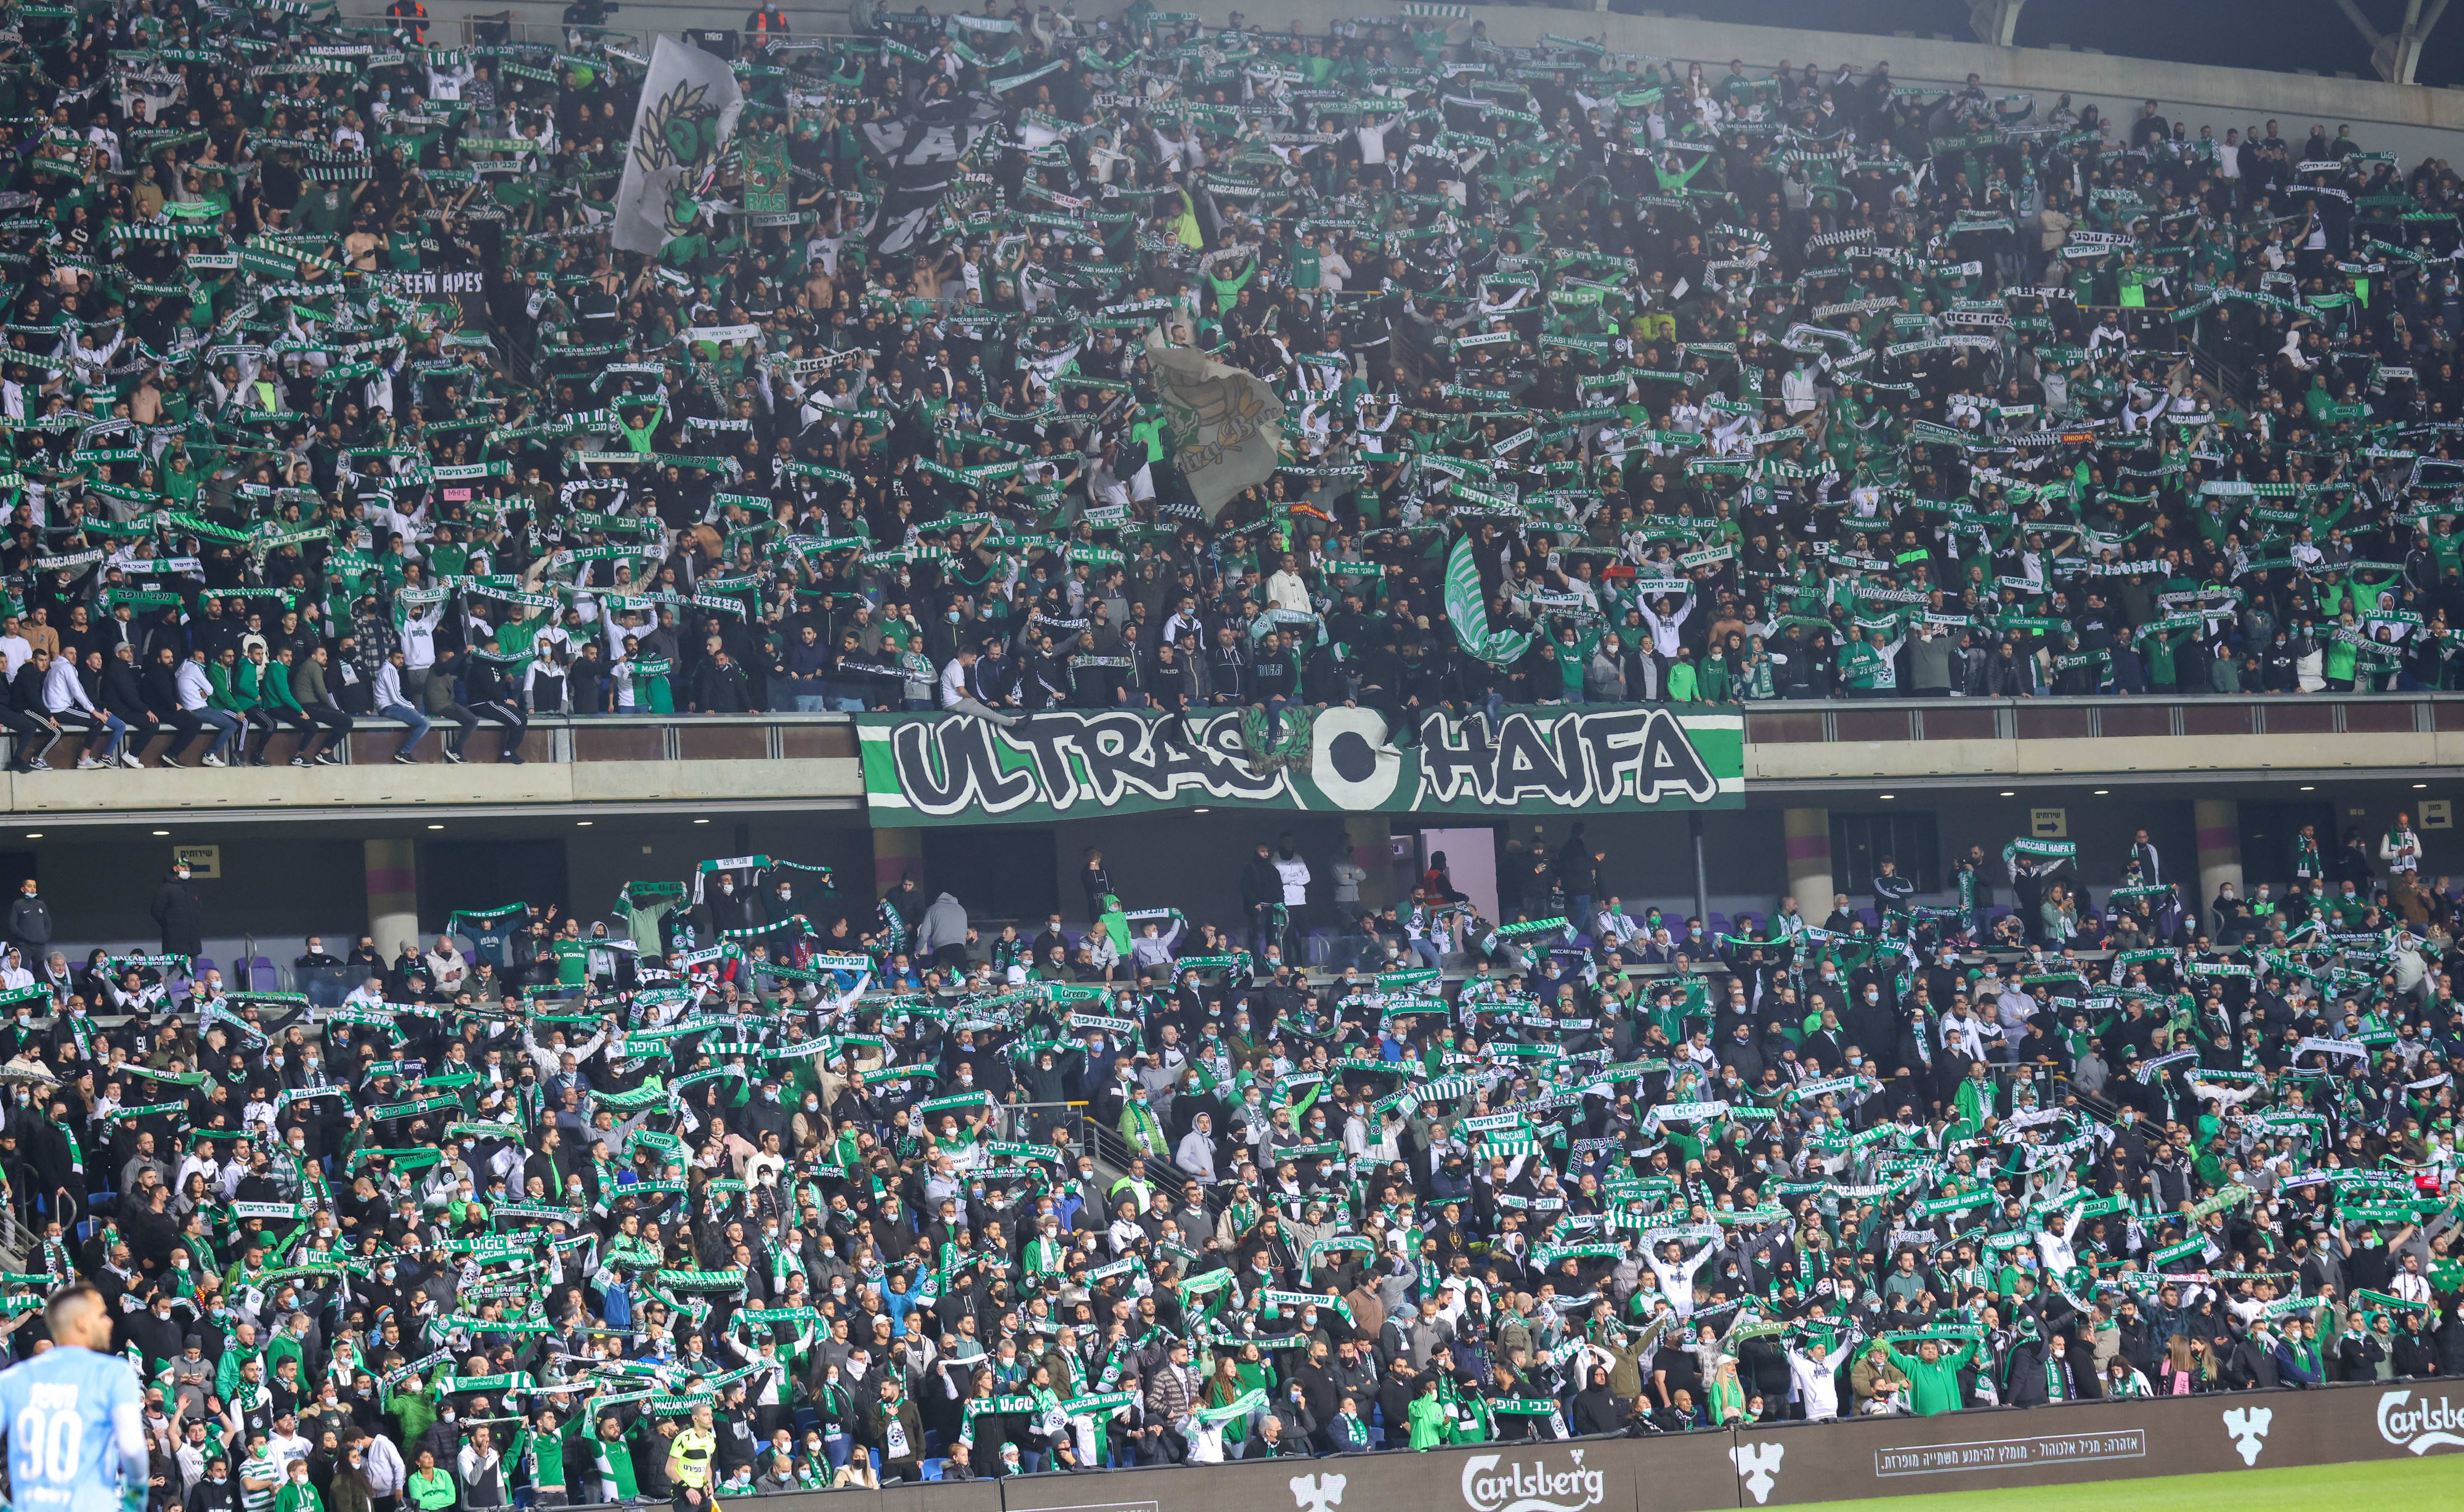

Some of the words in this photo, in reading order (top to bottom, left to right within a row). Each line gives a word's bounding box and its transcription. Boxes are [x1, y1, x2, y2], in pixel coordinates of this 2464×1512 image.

[309, 44, 373, 56] MACCABIHAIFA
[499, 139, 533, 150] מכבי
[476, 163, 496, 171] חיפה
[500, 161, 517, 169] מכבי
[745, 193, 787, 212] RAS
[189, 256, 213, 265] חיפה
[215, 254, 233, 264] מכבי
[1940, 266, 1961, 275] מכבי
[443, 272, 483, 293] APES
[1303, 356, 1332, 367] מכבי
[1584, 375, 1604, 385] חיפה
[1608, 371, 1626, 382] מכבי
[552, 423, 572, 433] חיפה
[588, 423, 607, 432] מכבי
[1516, 432, 1531, 442] מכבי
[1497, 439, 1515, 452] חיפה
[464, 466, 483, 474] מכבי
[1553, 461, 1574, 469] מכבי
[253, 486, 269, 496] HAIFA
[747, 495, 768, 508] מכבי
[1106, 508, 1120, 516] מכבי
[1291, 504, 1307, 513] UNION
[1950, 503, 1972, 513] מכבי
[2259, 509, 2298, 519] MACCABI
[577, 548, 606, 558] חיפה
[614, 545, 641, 555] מכבי
[1709, 547, 1728, 558] מכבי
[38, 549, 104, 568] MACCABIHAIFA
[1684, 554, 1707, 564] חיפה
[1838, 557, 1855, 566] HAIFA
[1868, 561, 1883, 570] CITY
[2069, 656, 2086, 666] חיפה
[1257, 664, 1283, 677] BOSS
[891, 712, 1286, 818] ULTRAS
[1420, 709, 1720, 808] HAIFA
[2016, 839, 2047, 853] MACCABI
[2048, 842, 2070, 853] HAIFA
[180, 850, 213, 858] שירותים
[697, 949, 718, 959] מכבי
[821, 957, 845, 965] חיפה
[846, 957, 865, 965] מכבי
[2194, 964, 2221, 973] חיפה
[2224, 964, 2251, 974] מכבי
[1388, 1001, 1414, 1010] MACCABI
[2054, 998, 2075, 1007] HAIFA
[2090, 999, 2108, 1008] CITY
[959, 1008, 991, 1018] MACCABI
[992, 1014, 1011, 1022] HAIFA
[1075, 1016, 1101, 1025] חיפה
[1103, 1019, 1130, 1029] מכבי
[857, 1033, 873, 1041] HAIFA
[629, 1041, 660, 1053] חיפה
[808, 1038, 827, 1048] מכבי
[1493, 1043, 1515, 1052] חיפה
[784, 1044, 807, 1054] חיפה
[1534, 1045, 1560, 1055] מכבי
[154, 1070, 180, 1080] HAIFA
[918, 1099, 951, 1108] MACCABI
[1493, 1115, 1515, 1123] מכבי
[2265, 1113, 2295, 1122] MACCABI
[2296, 1113, 2315, 1121] HAIFA
[2316, 1113, 2325, 1121] FC
[1493, 1131, 1525, 1140] MACCABI
[989, 1141, 1019, 1152] חיפה
[1027, 1145, 1058, 1156] מכבי
[962, 1168, 996, 1178] MACCABI
[1508, 1197, 1526, 1208] HAIFA
[1539, 1198, 1559, 1209] CITY
[1930, 1197, 1959, 1210] MACCABI
[1961, 1193, 1979, 1206] HAIFA
[1980, 1192, 1990, 1201] FC
[238, 1204, 265, 1212] חיפה
[1113, 1259, 1129, 1269] מכבי
[1096, 1266, 1113, 1275] חיפה
[2136, 1273, 2160, 1281] חיפה
[1302, 1295, 1329, 1304] מכבי
[654, 1400, 682, 1410] MACCABI
[683, 1398, 700, 1409] HAIFA
[1064, 1396, 1100, 1412] MACCABI
[1100, 1393, 1124, 1405] HAIFA
[1125, 1390, 1135, 1400] FC
[17, 1410, 84, 1481] 90
[2040, 1441, 2077, 1457] אלכוהול
[2080, 1440, 2101, 1453] מכיל
[1926, 1451, 1958, 1465] משתייה
[1963, 1448, 1995, 1463] להימנע
[2000, 1445, 2028, 1462] מומלץ
[1462, 1453, 1604, 1511] Carlsberg
